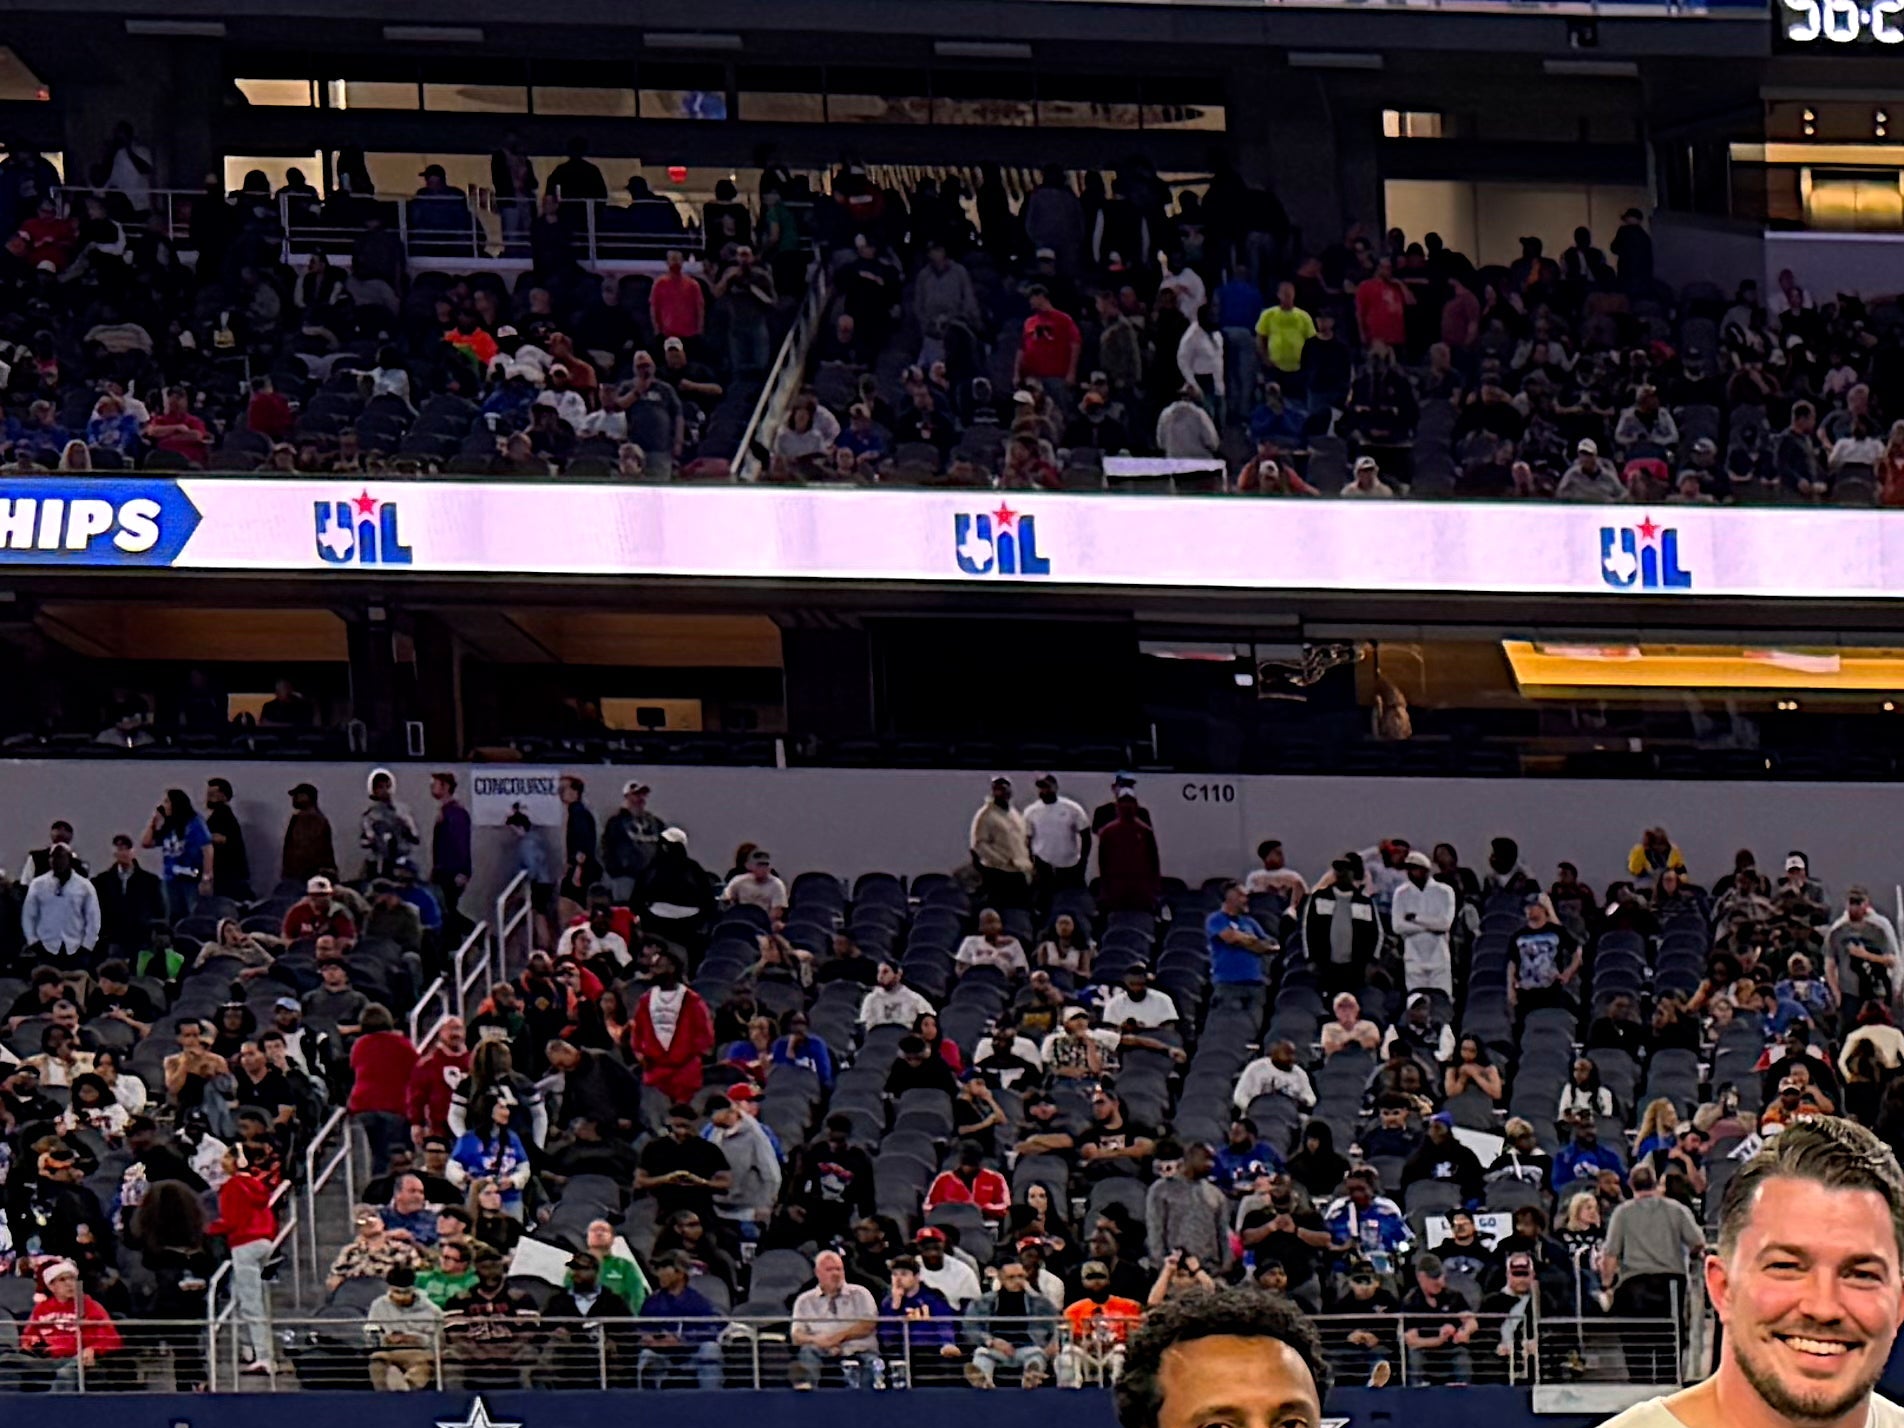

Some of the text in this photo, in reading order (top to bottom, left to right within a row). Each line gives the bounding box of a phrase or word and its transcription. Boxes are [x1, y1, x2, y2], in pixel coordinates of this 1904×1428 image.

[314, 489, 412, 564] UIL
[955, 501, 1050, 577] UIL
[1600, 516, 1692, 589] UIL
[1182, 783, 1235, 802] C110
